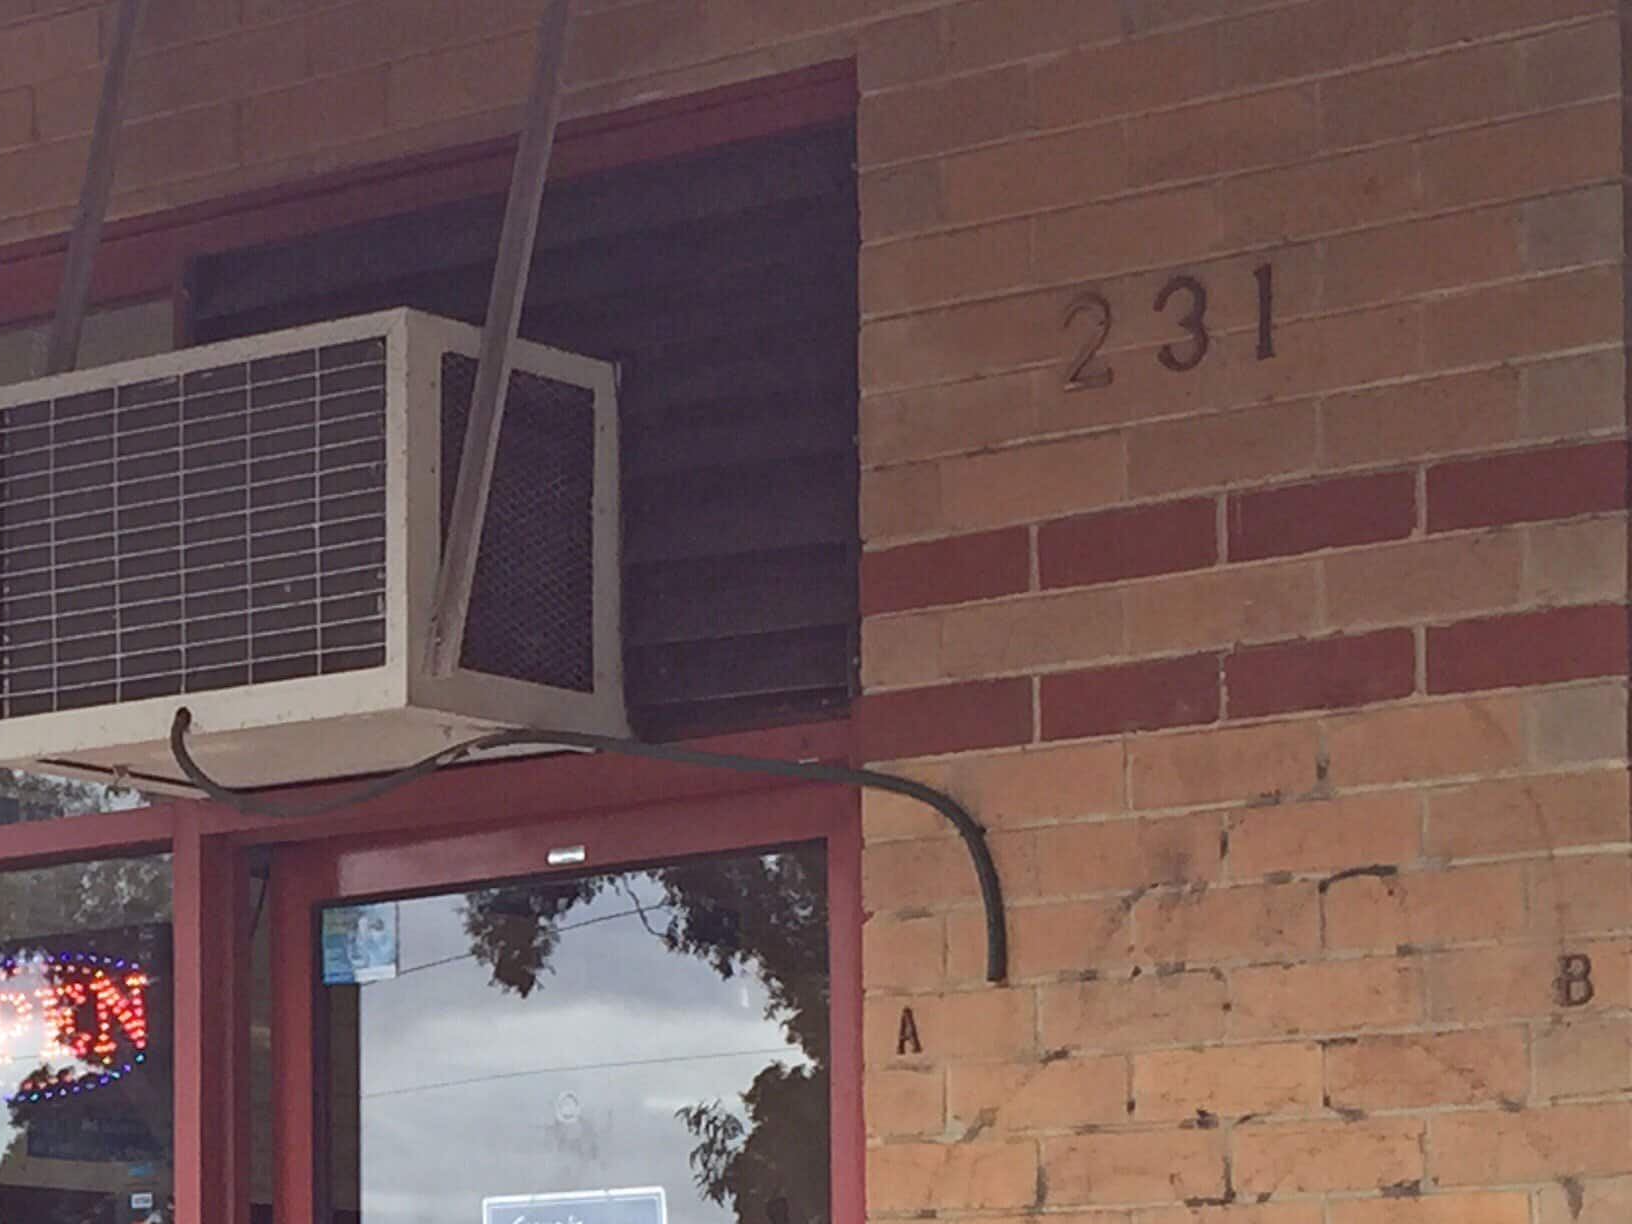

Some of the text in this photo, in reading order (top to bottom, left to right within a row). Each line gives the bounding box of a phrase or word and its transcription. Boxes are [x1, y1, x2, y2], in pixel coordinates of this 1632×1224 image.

[1062, 263, 1277, 392] 231
[1551, 954, 1596, 1007] B
[895, 1007, 922, 1055] A
